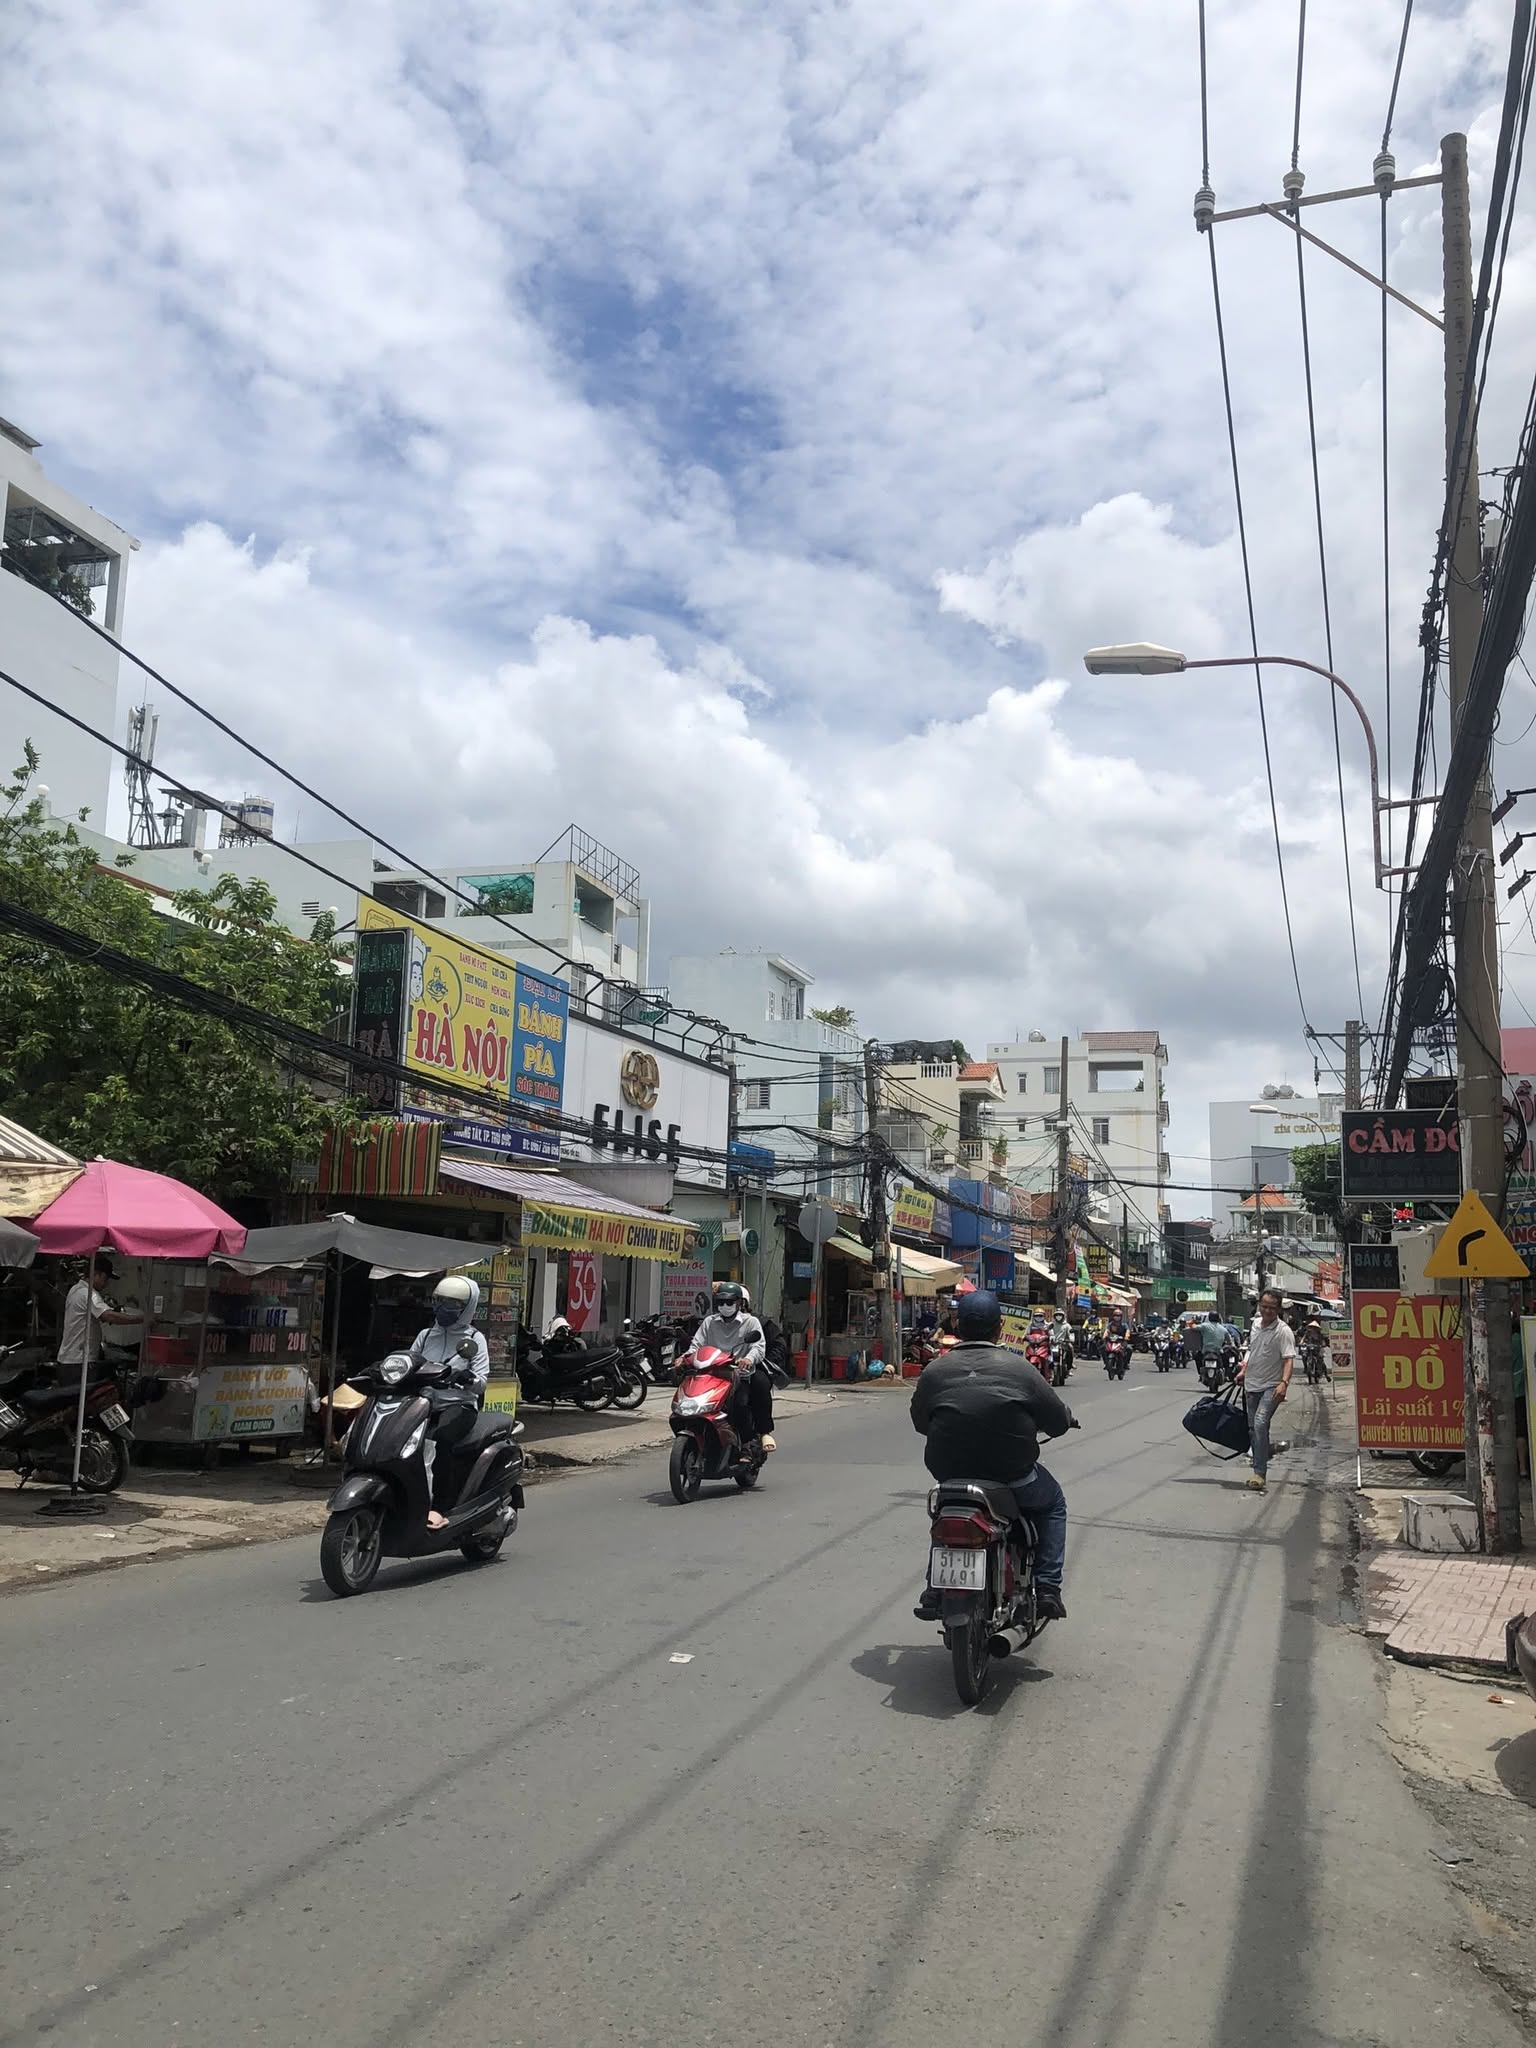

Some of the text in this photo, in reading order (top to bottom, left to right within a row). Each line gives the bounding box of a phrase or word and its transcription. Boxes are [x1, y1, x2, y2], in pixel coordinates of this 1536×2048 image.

[518, 1001, 563, 1042] BÁNH
[415, 1002, 508, 1090] HÀ NỘI
[524, 1040, 556, 1078] PÍA
[516, 1074, 534, 1095] SÓC
[593, 1103, 681, 1171] ELISE
[1349, 1117, 1415, 1153] CẦM
[532, 1208, 569, 1239] BÁNH
[571, 1213, 588, 1240] MÌ
[588, 1216, 602, 1242] HÀ
[605, 1219, 625, 1249] NỘI
[627, 1223, 657, 1250] CHÍNH
[659, 1228, 680, 1255] HIỆU
[1355, 1250, 1393, 1268] BÁN &
[570, 1261, 596, 1309] 30
[1359, 1296, 1463, 1339] CẦM
[223, 1368, 260, 1383] BÁNH
[1382, 1344, 1444, 1390] ĐỒ
[215, 1388, 254, 1403] BÁNH
[1361, 1397, 1391, 1416] Lãi
[1396, 1395, 1434, 1417] suất
[1361, 1419, 1392, 1442] CHUYỂN
[1412, 1422, 1428, 1443] VÀO
[1430, 1424, 1443, 1444] TÀI
[940, 1569, 975, 1585] 4491
[941, 1551, 976, 1569] 51-U1
